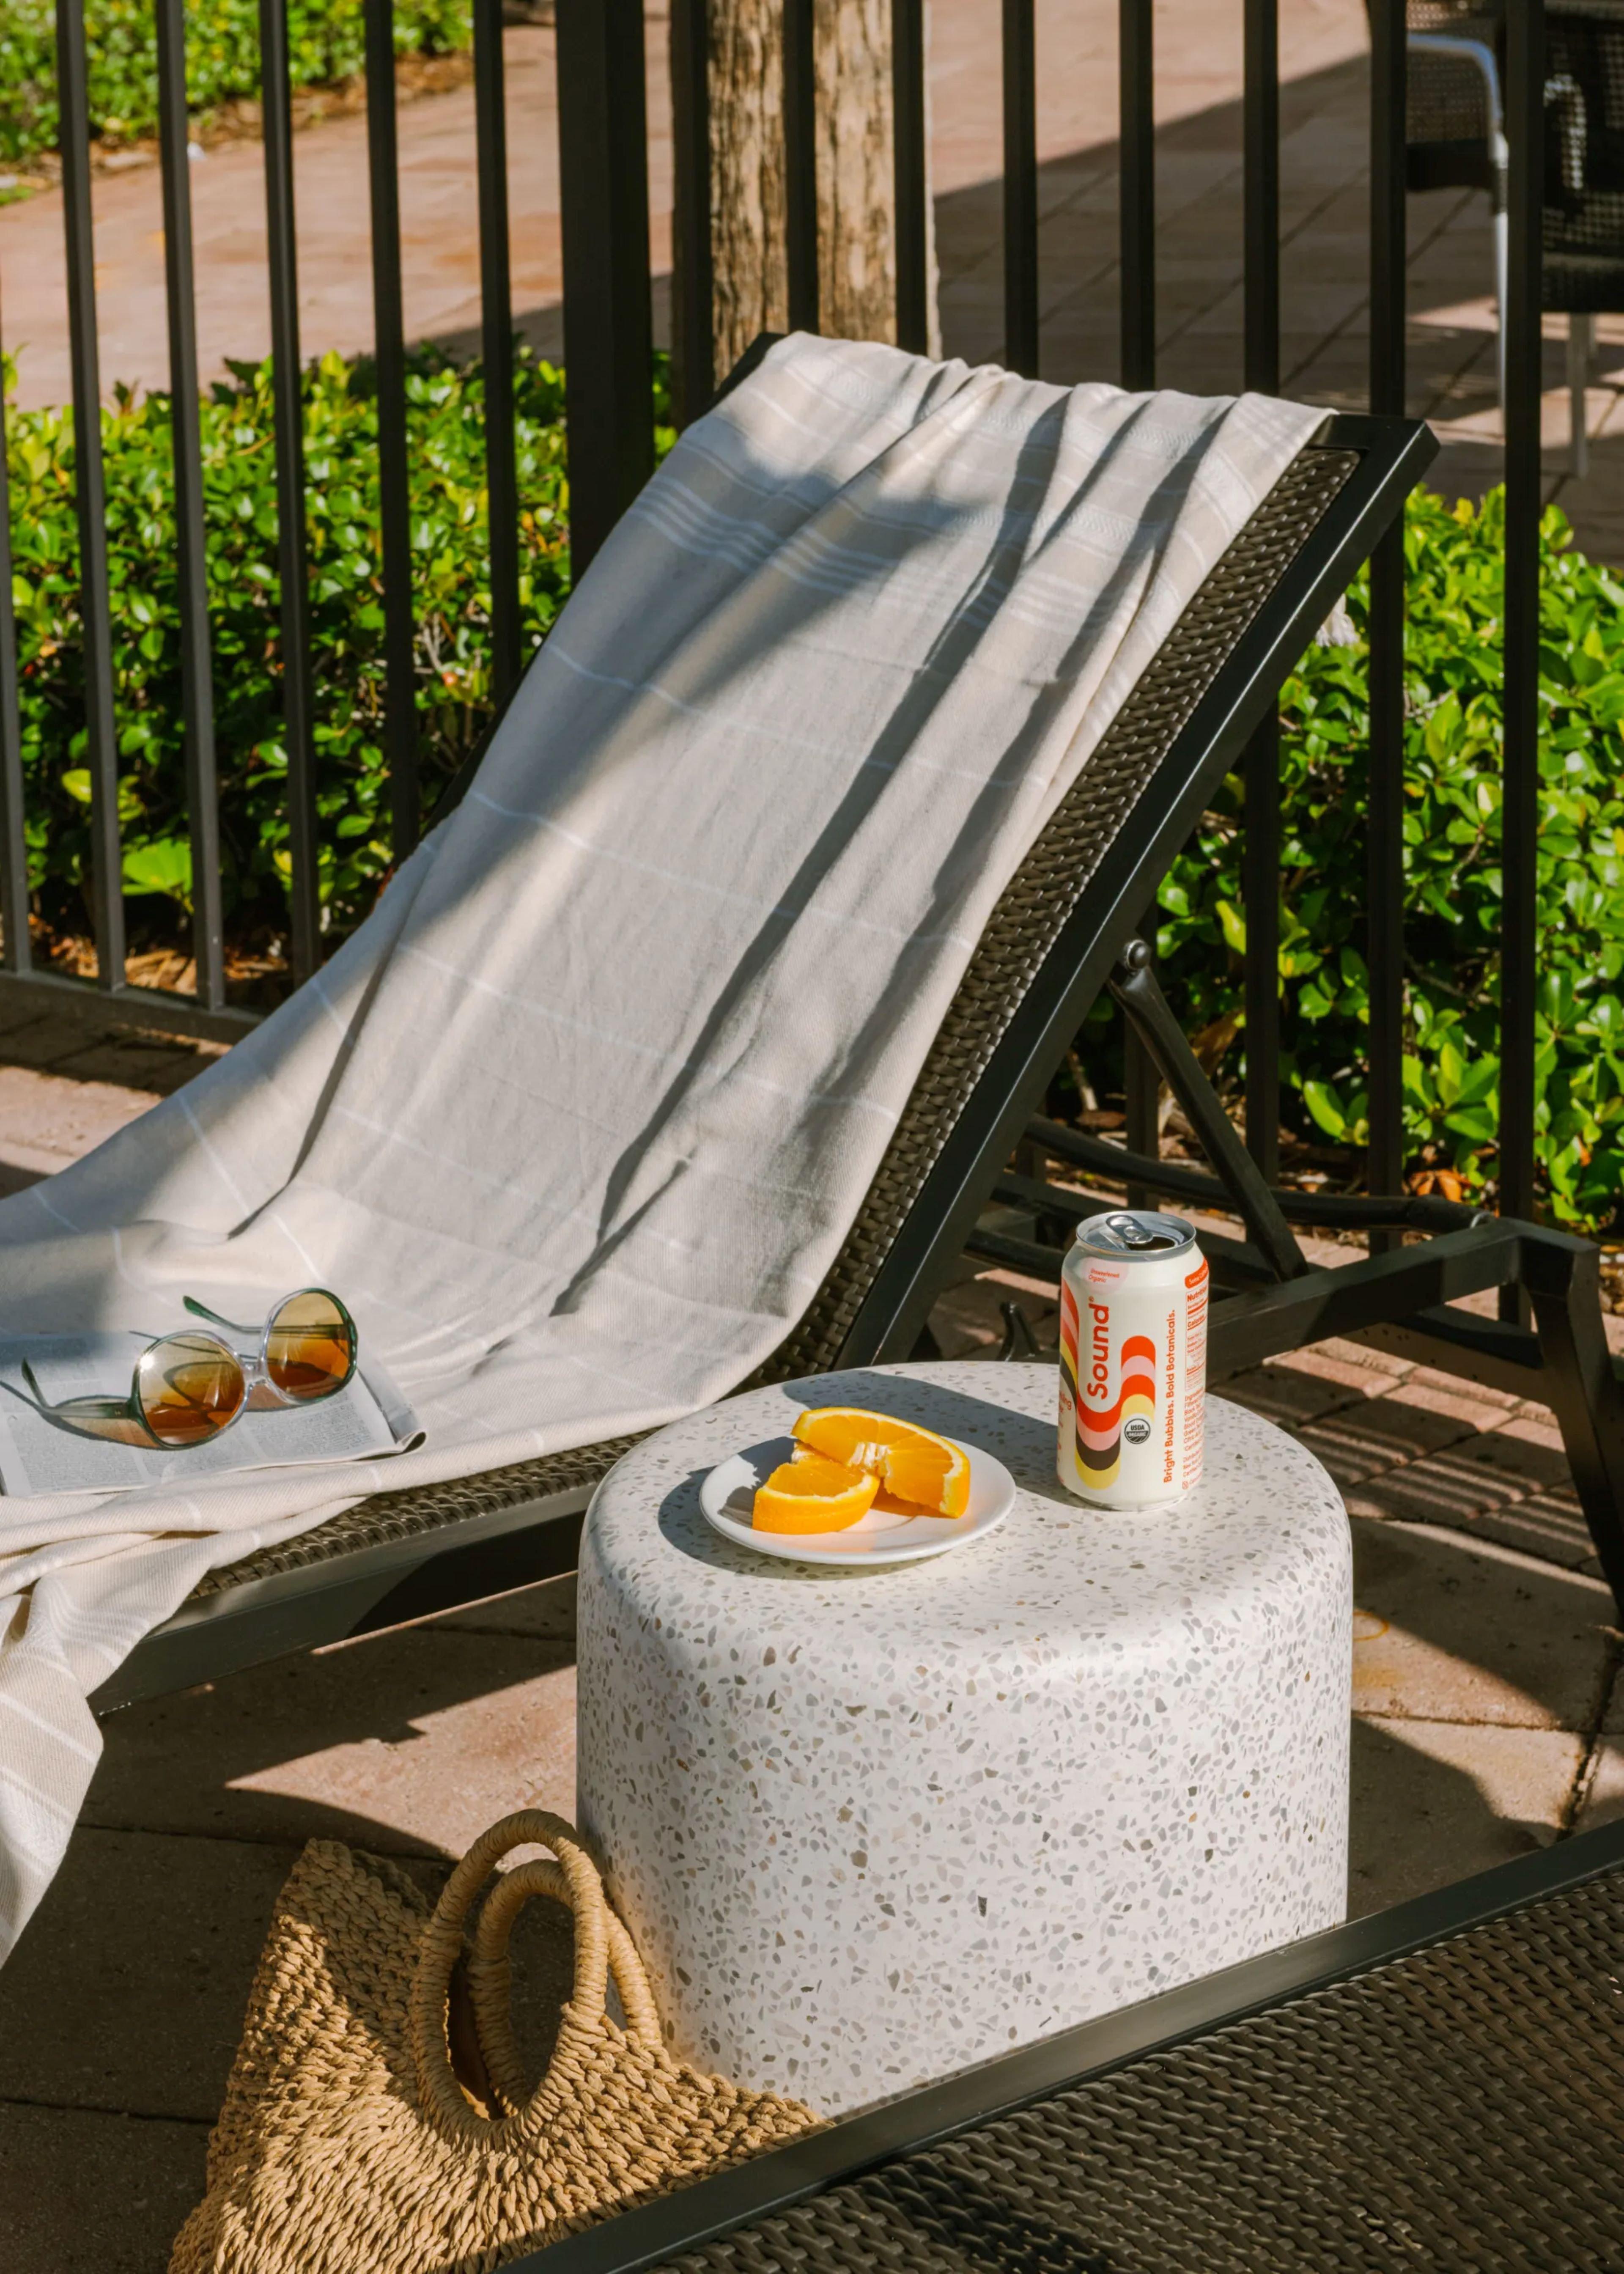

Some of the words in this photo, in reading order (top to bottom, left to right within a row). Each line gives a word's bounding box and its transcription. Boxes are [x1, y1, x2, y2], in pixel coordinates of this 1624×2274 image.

[1089, 1274, 1106, 1283] Organic
[1166, 1309, 1175, 1371] Botanicals.
[1166, 1373, 1174, 1398] Bold
[1165, 1400, 1174, 1447] Bubbles.
[1163, 1450, 1175, 1483] Bright
